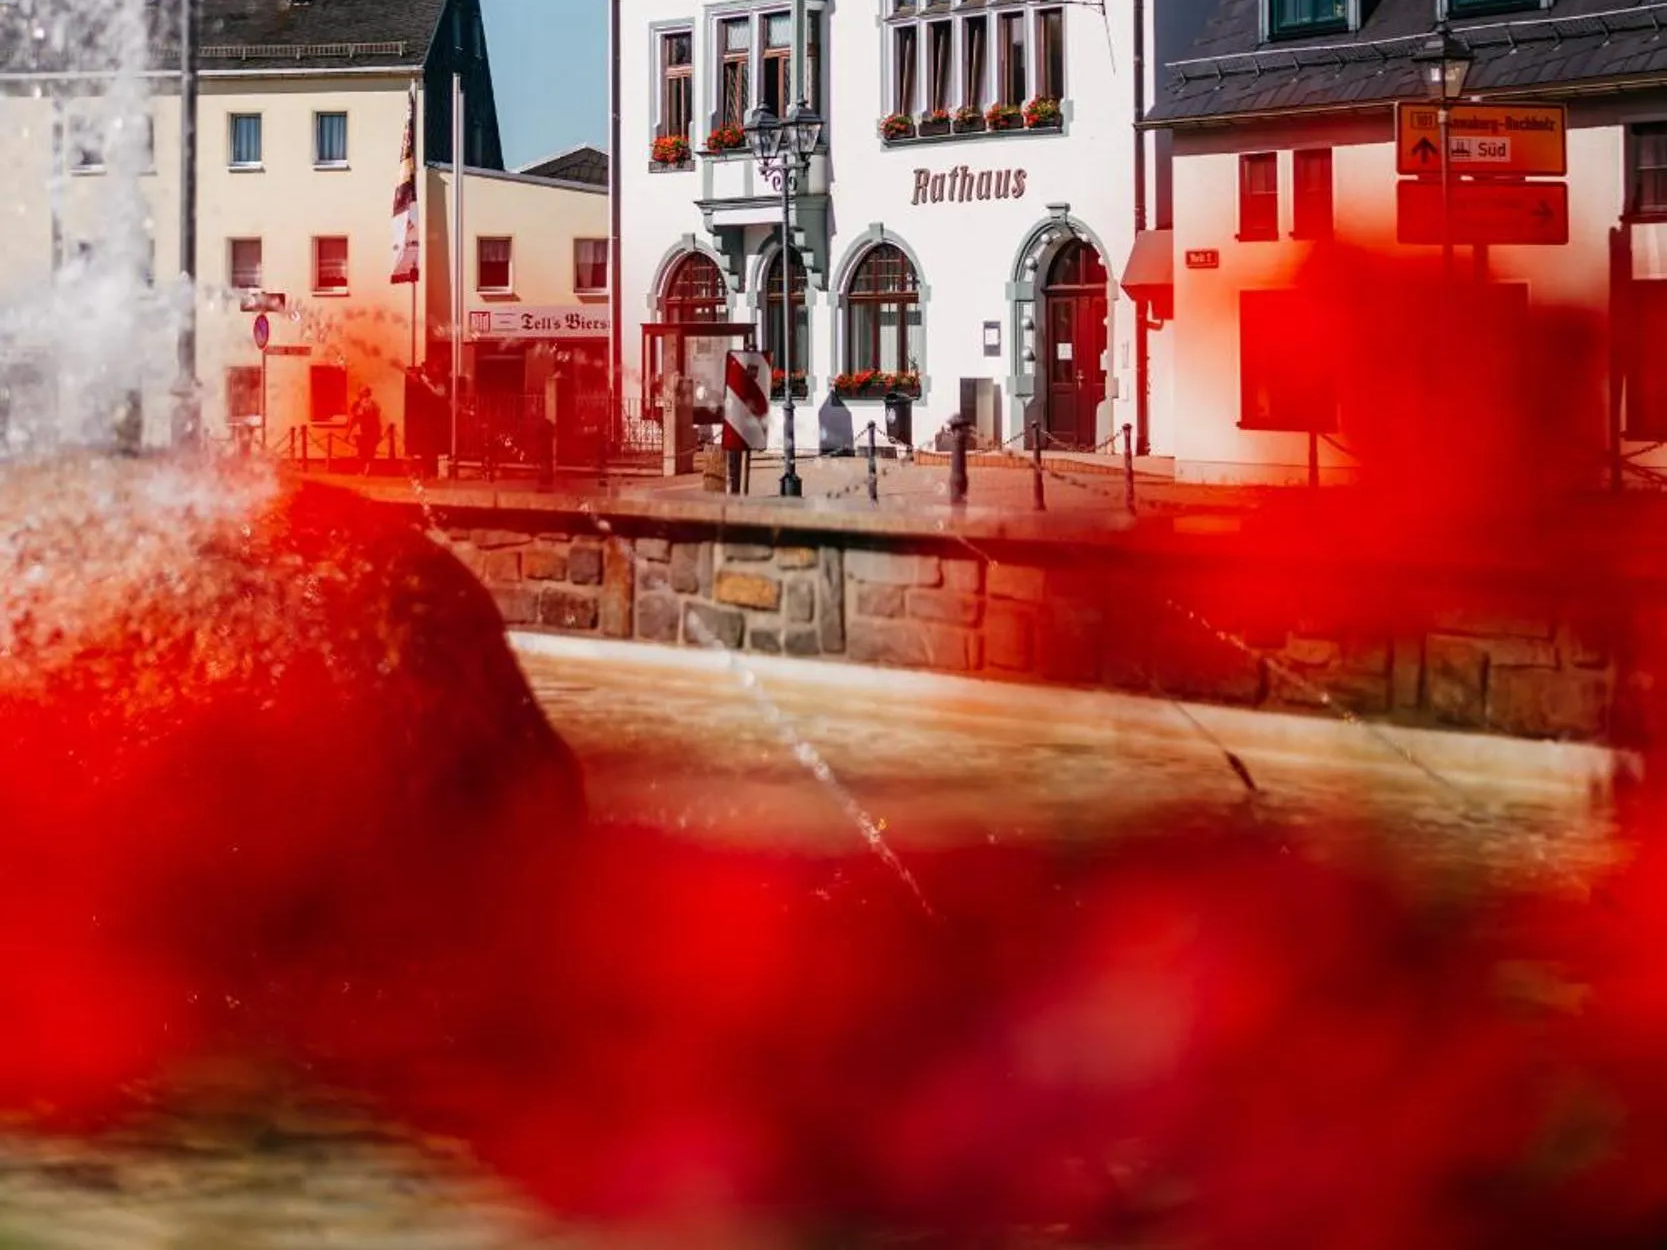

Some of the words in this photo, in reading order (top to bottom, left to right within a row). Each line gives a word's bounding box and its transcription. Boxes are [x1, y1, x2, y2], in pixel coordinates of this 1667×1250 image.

[1477, 142, 1507, 158] Süd
[911, 165, 1028, 206] Rathaus
[564, 312, 611, 331] Biers
